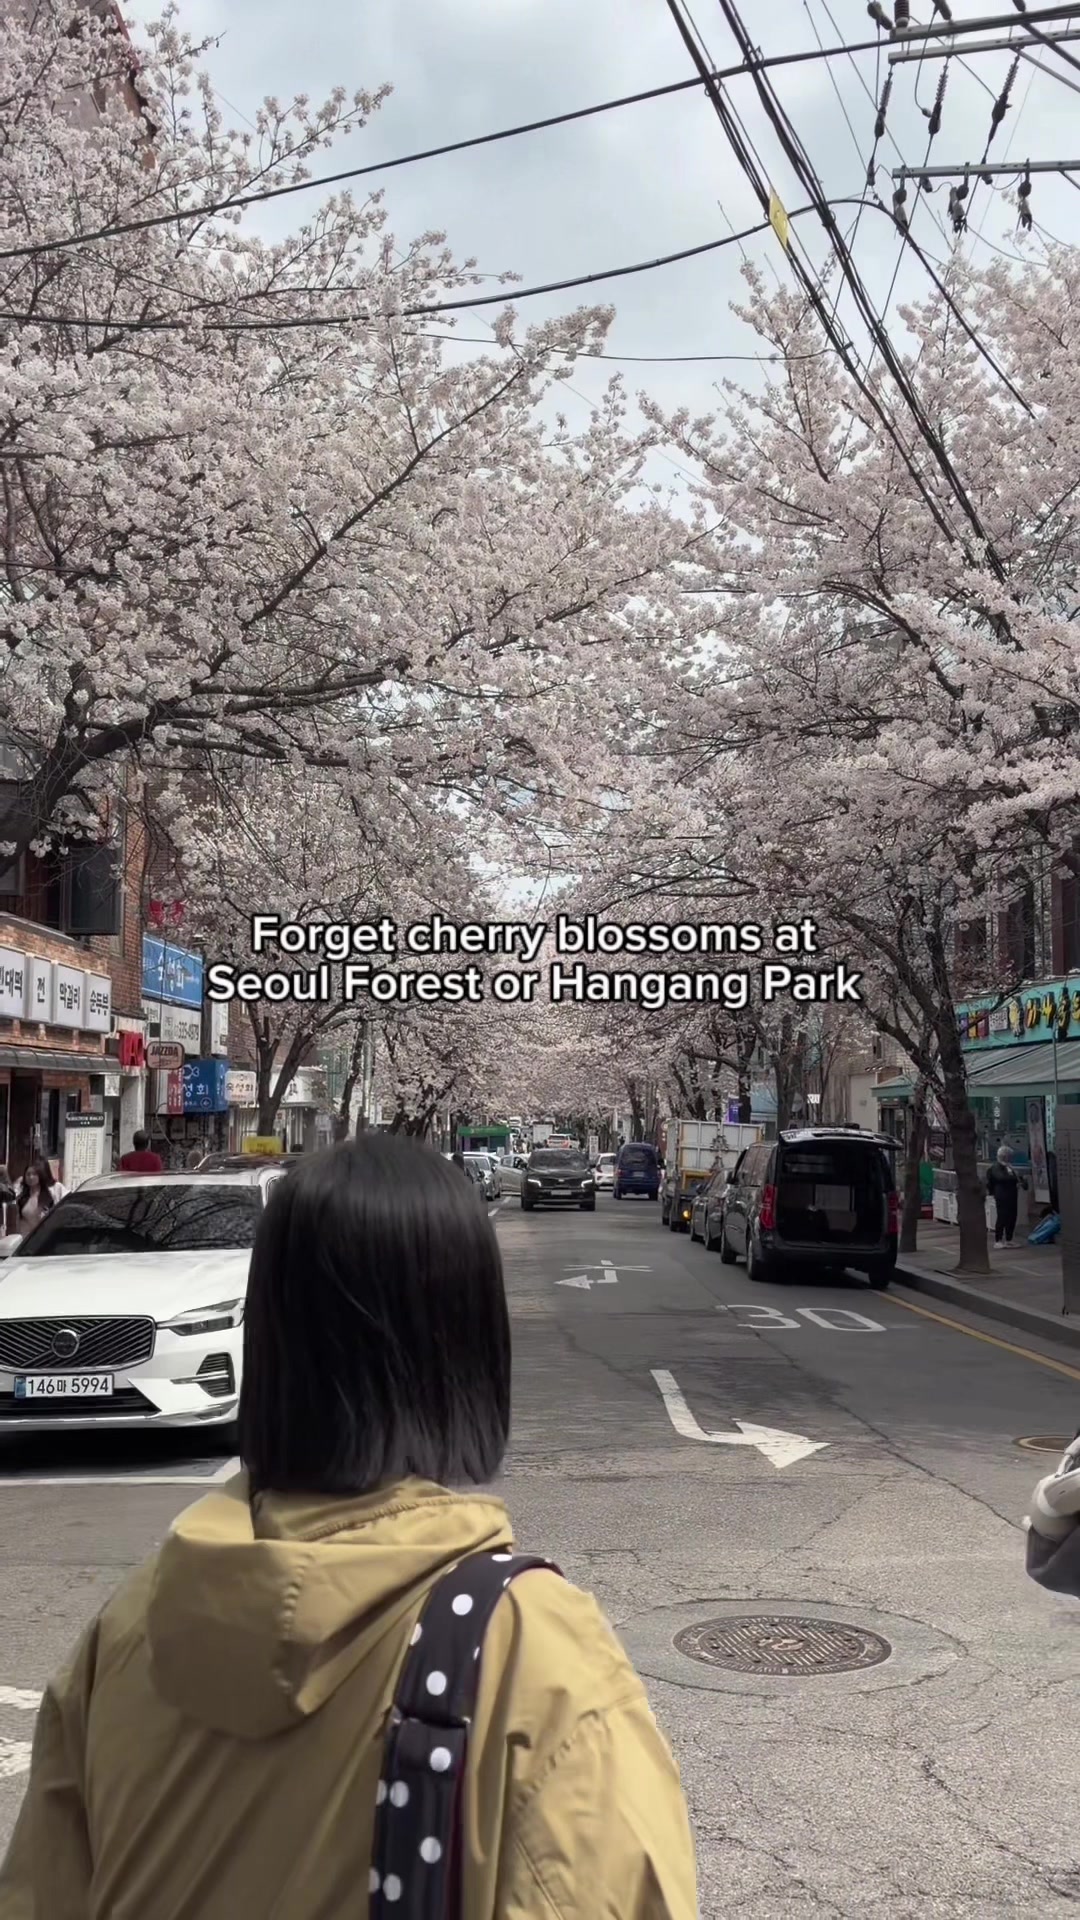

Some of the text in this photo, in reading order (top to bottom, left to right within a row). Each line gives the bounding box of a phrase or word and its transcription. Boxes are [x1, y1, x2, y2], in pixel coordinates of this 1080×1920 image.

[37, 977, 46, 1003] 전
[59, 982, 81, 1011] 막걸리
[90, 990, 109, 1016] 순두부
[714, 1304, 887, 1332] 30
[28, 1377, 109, 1394] 146마 5994
